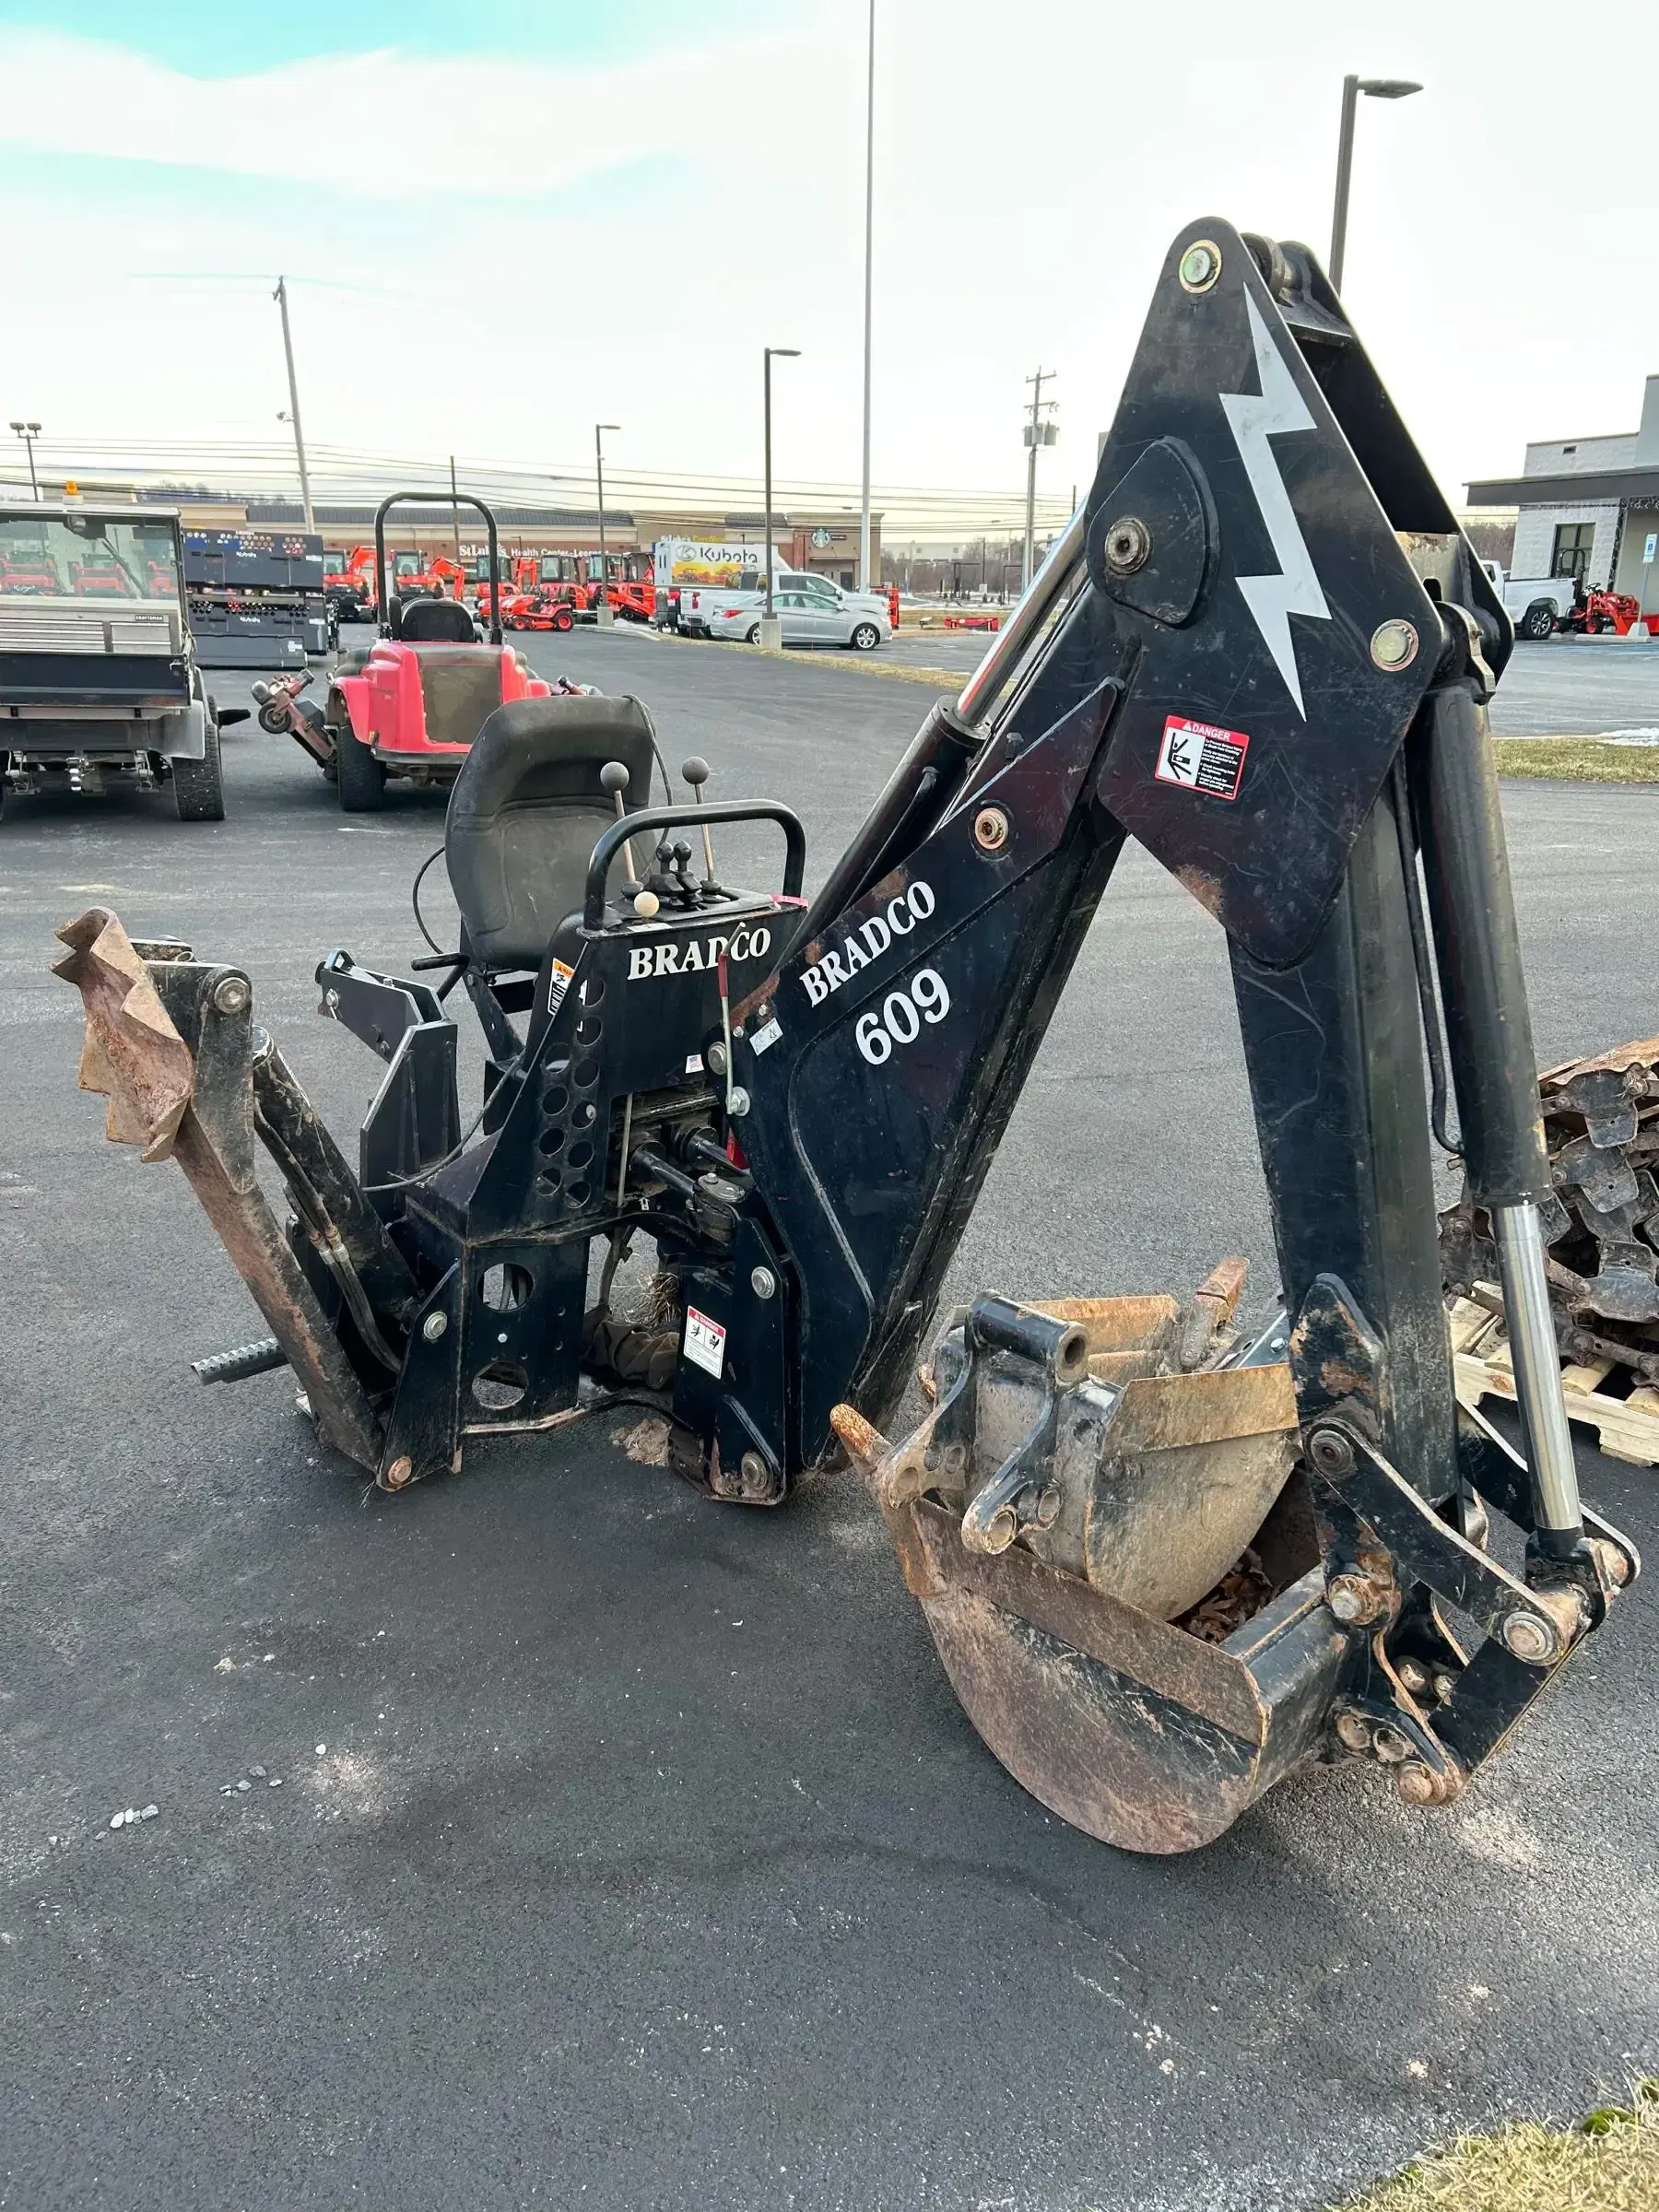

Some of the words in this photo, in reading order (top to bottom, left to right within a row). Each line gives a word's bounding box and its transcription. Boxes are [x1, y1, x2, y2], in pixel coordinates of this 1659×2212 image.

[700, 547, 758, 563] Kubota
[1192, 724, 1230, 742] DANGER
[628, 927, 771, 980] BRADCO
[800, 880, 935, 1007] BRADCO
[855, 969, 951, 1065] 609
